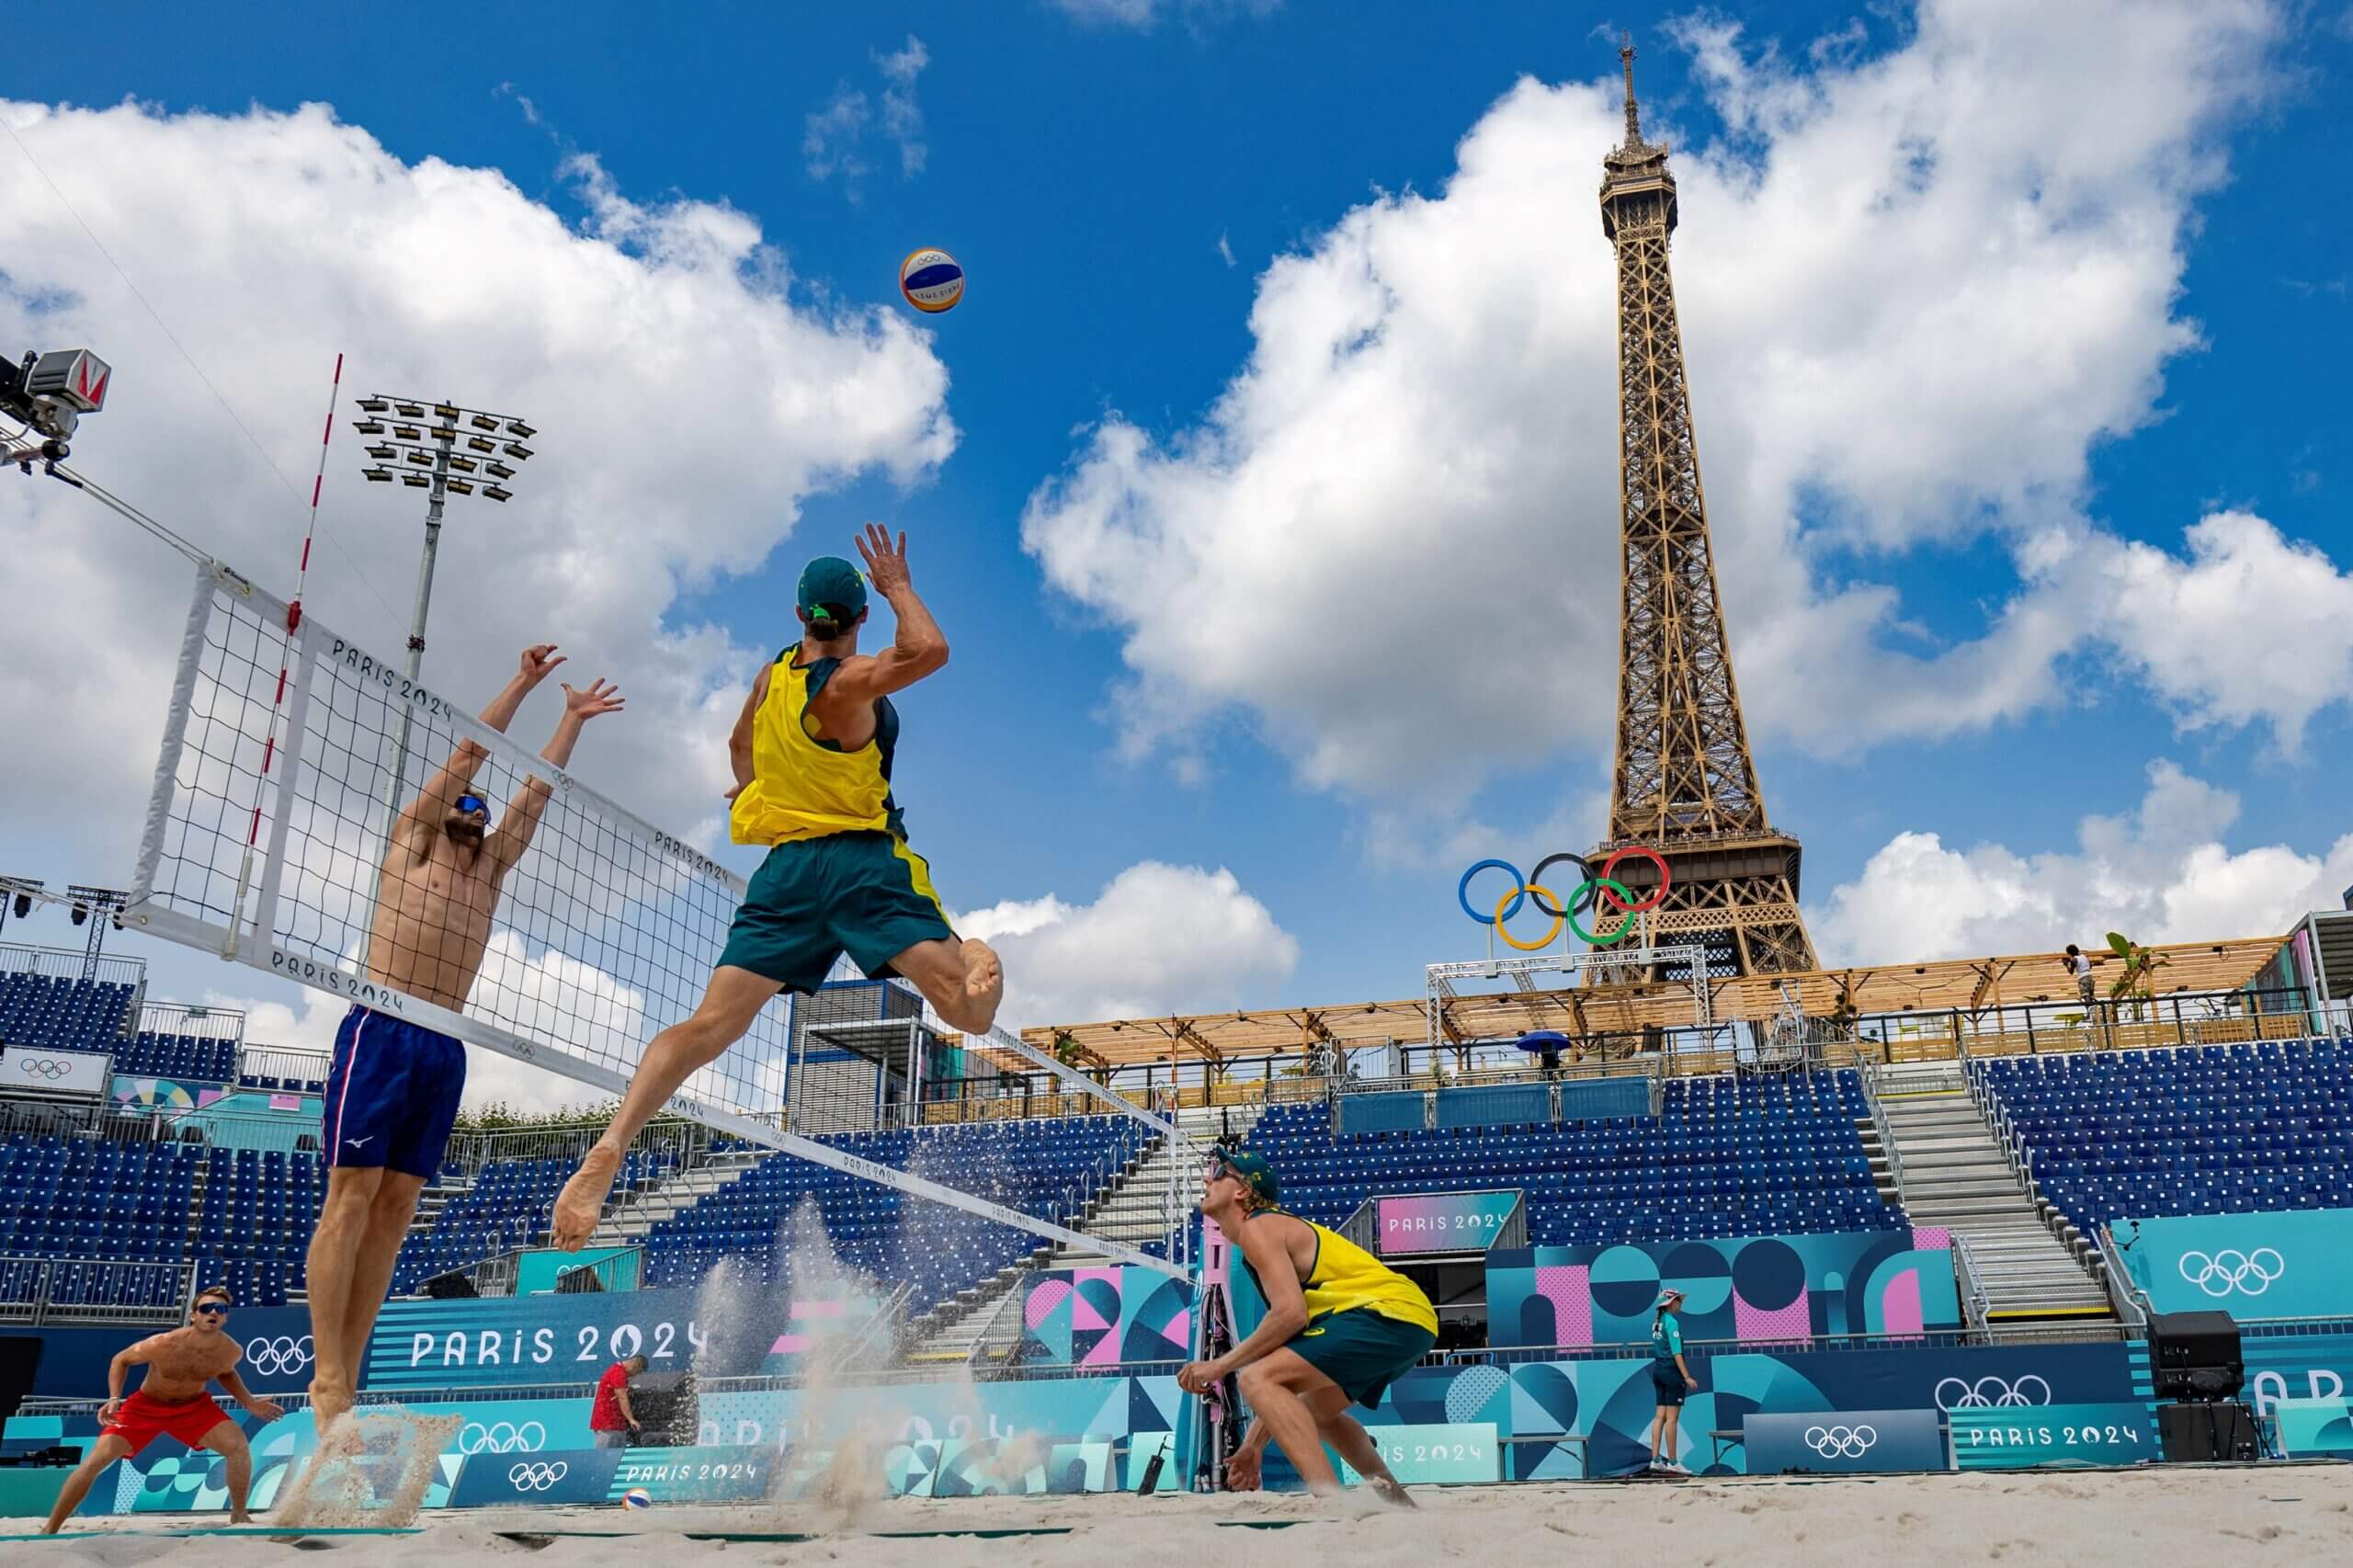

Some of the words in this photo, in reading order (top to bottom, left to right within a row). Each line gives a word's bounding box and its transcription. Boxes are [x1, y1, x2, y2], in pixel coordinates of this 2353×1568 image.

[400, 680, 451, 722] 2024
[697, 855, 728, 882] 2024
[347, 979, 404, 1013] 2024
[670, 1096, 705, 1119] 2024
[576, 1322, 708, 1361] 2024
[2063, 1426, 2138, 1444] 2024
[1415, 1444, 1482, 1461] 2024
[699, 1463, 757, 1480] 2024
